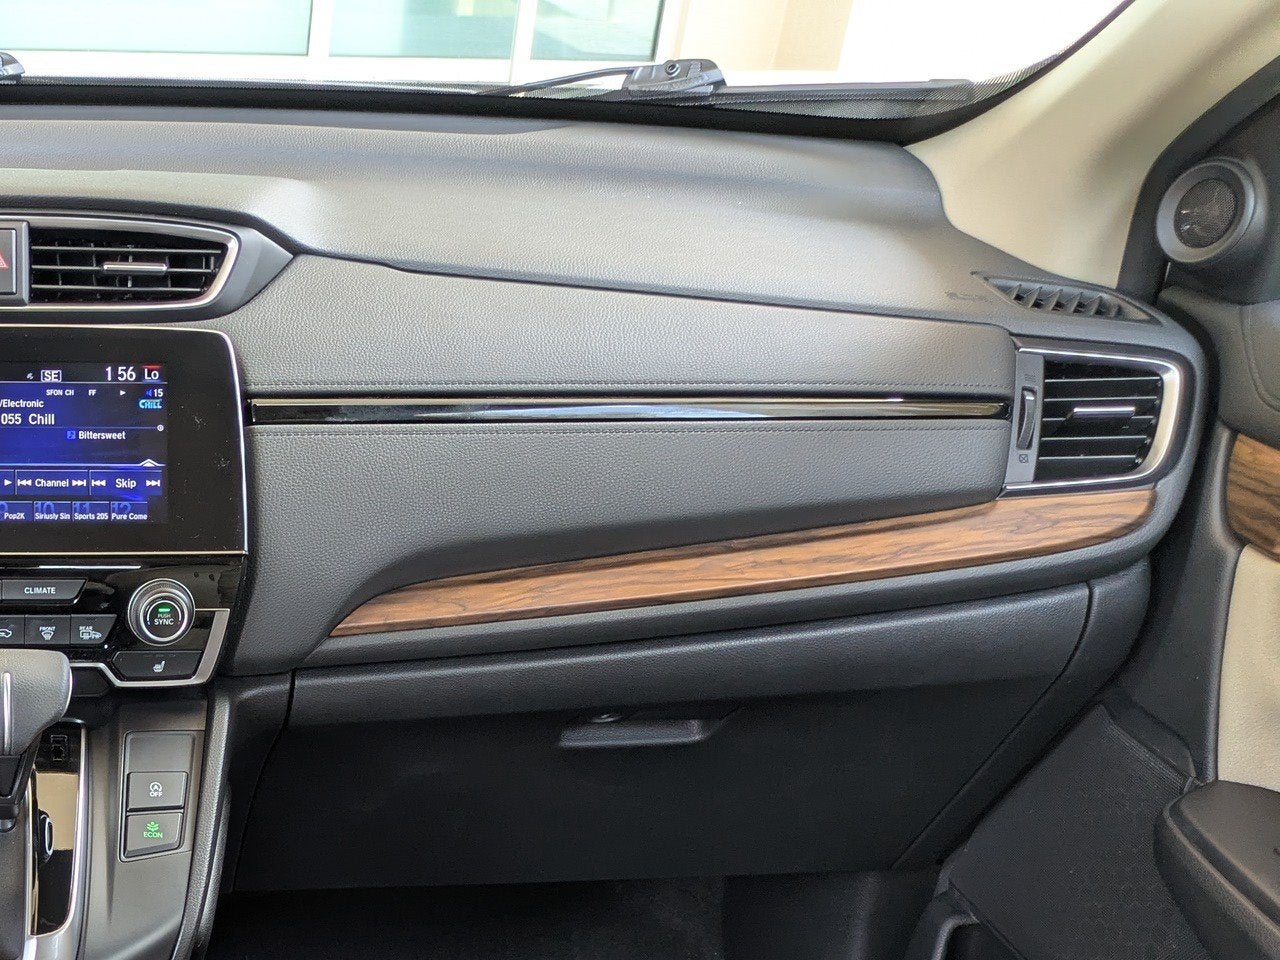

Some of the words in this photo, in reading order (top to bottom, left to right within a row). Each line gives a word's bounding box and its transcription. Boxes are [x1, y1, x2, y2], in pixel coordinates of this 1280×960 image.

[144, 367, 160, 380] Lo
[1, 413, 22, 425] 055
[29, 413, 55, 425] Chill
[78, 430, 127, 440] Bittersweet
[35, 478, 69, 488] Channel
[115, 478, 137, 489] Skip
[111, 511, 127, 520] Pure
[129, 511, 148, 520] Come
[24, 586, 56, 595] CLIMATE
[154, 618, 174, 626] SYNC
[143, 831, 164, 839] ECON
